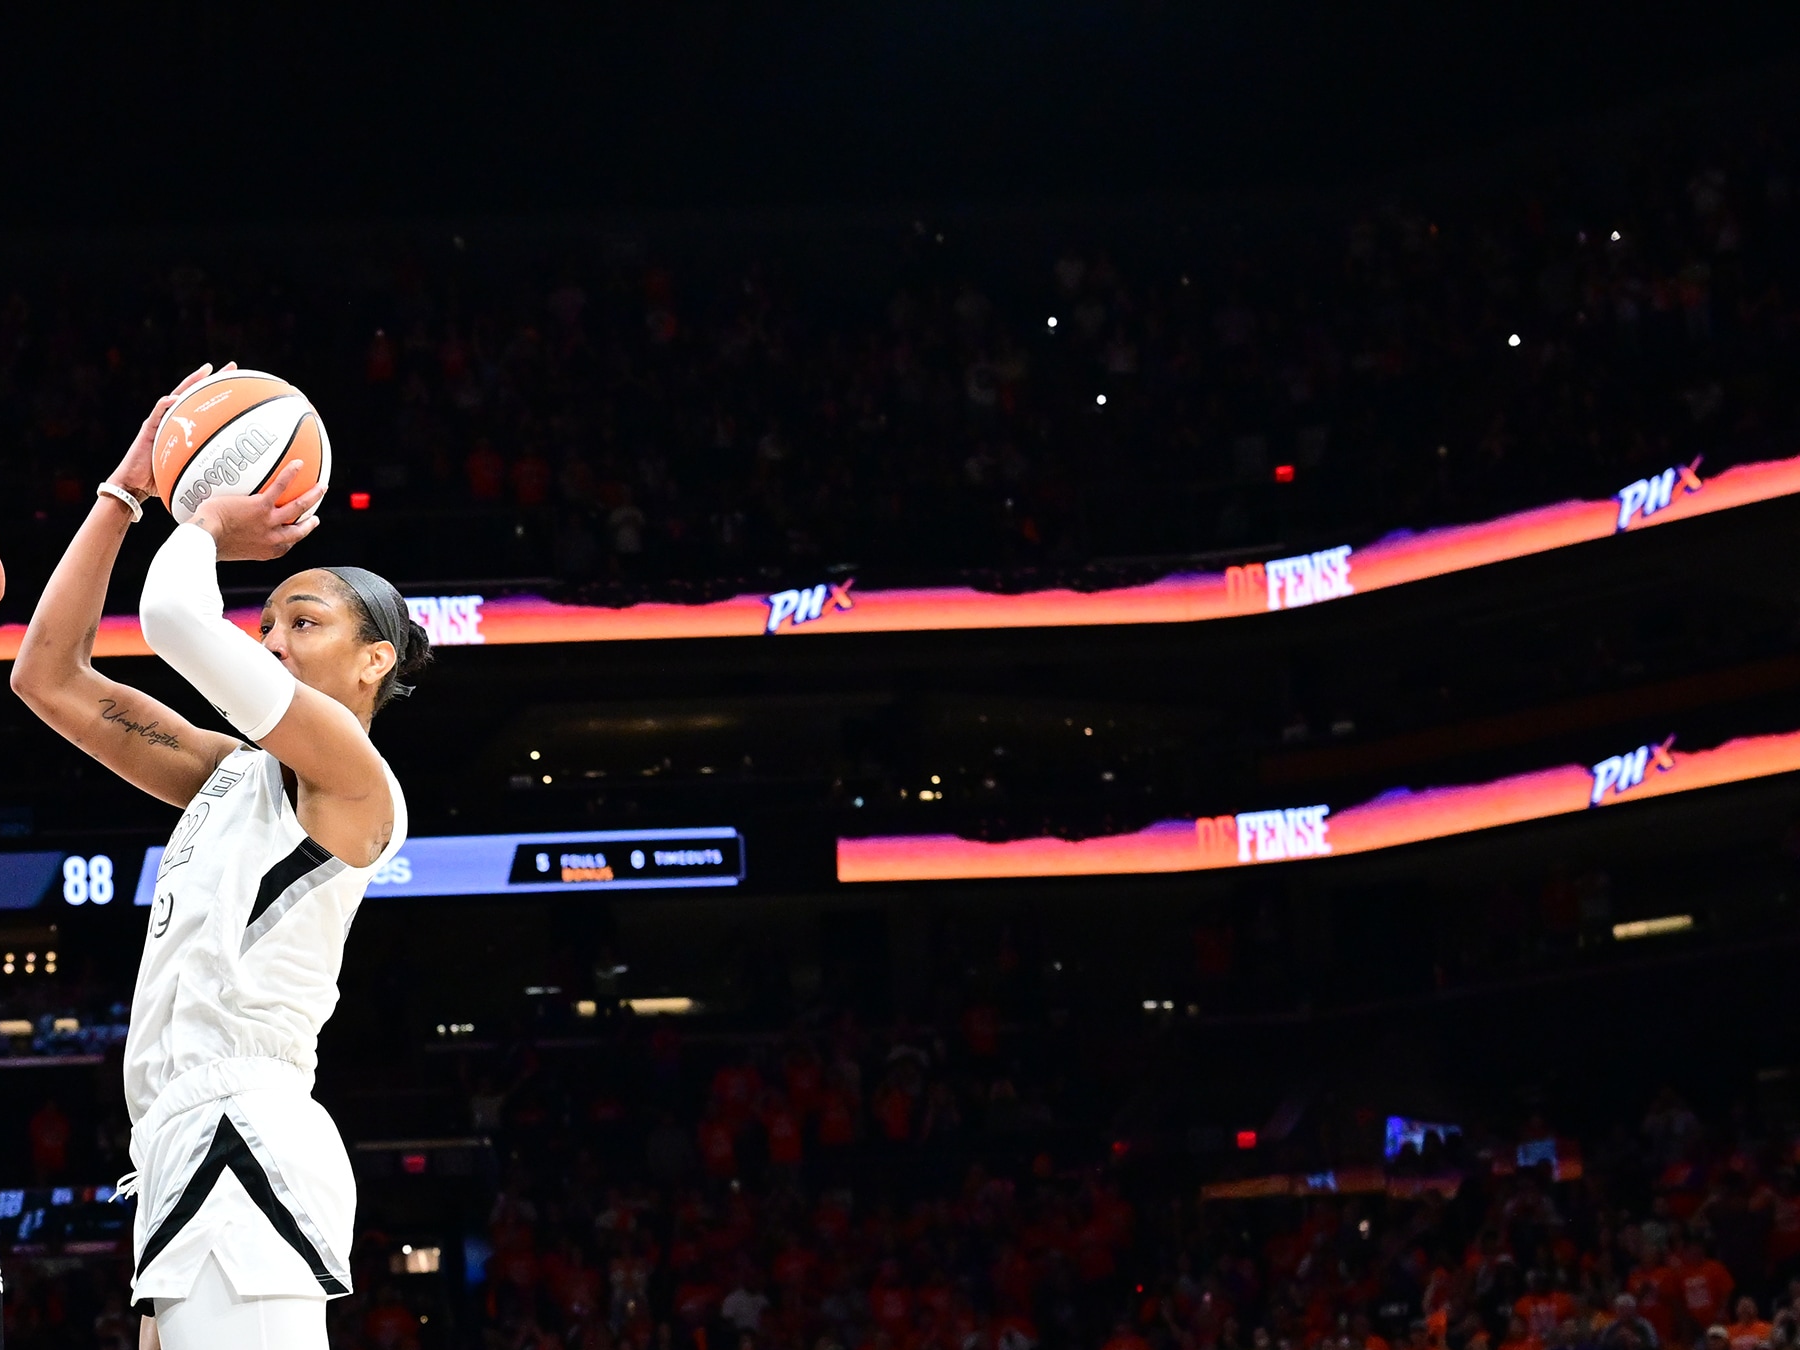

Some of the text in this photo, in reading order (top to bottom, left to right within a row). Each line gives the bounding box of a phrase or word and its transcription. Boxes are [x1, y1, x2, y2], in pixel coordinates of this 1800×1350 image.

[179, 423, 278, 514] Wilson
[1613, 456, 1704, 532] PHX
[764, 577, 855, 635] PHX
[1225, 545, 1354, 611] DEFENSE
[404, 595, 485, 646] ENSE
[99, 699, 181, 751] Unapologetic
[1590, 734, 1677, 808] PHX
[1196, 804, 1332, 862] DEFENSE
[63, 855, 115, 905] 88
[373, 855, 413, 885] es
